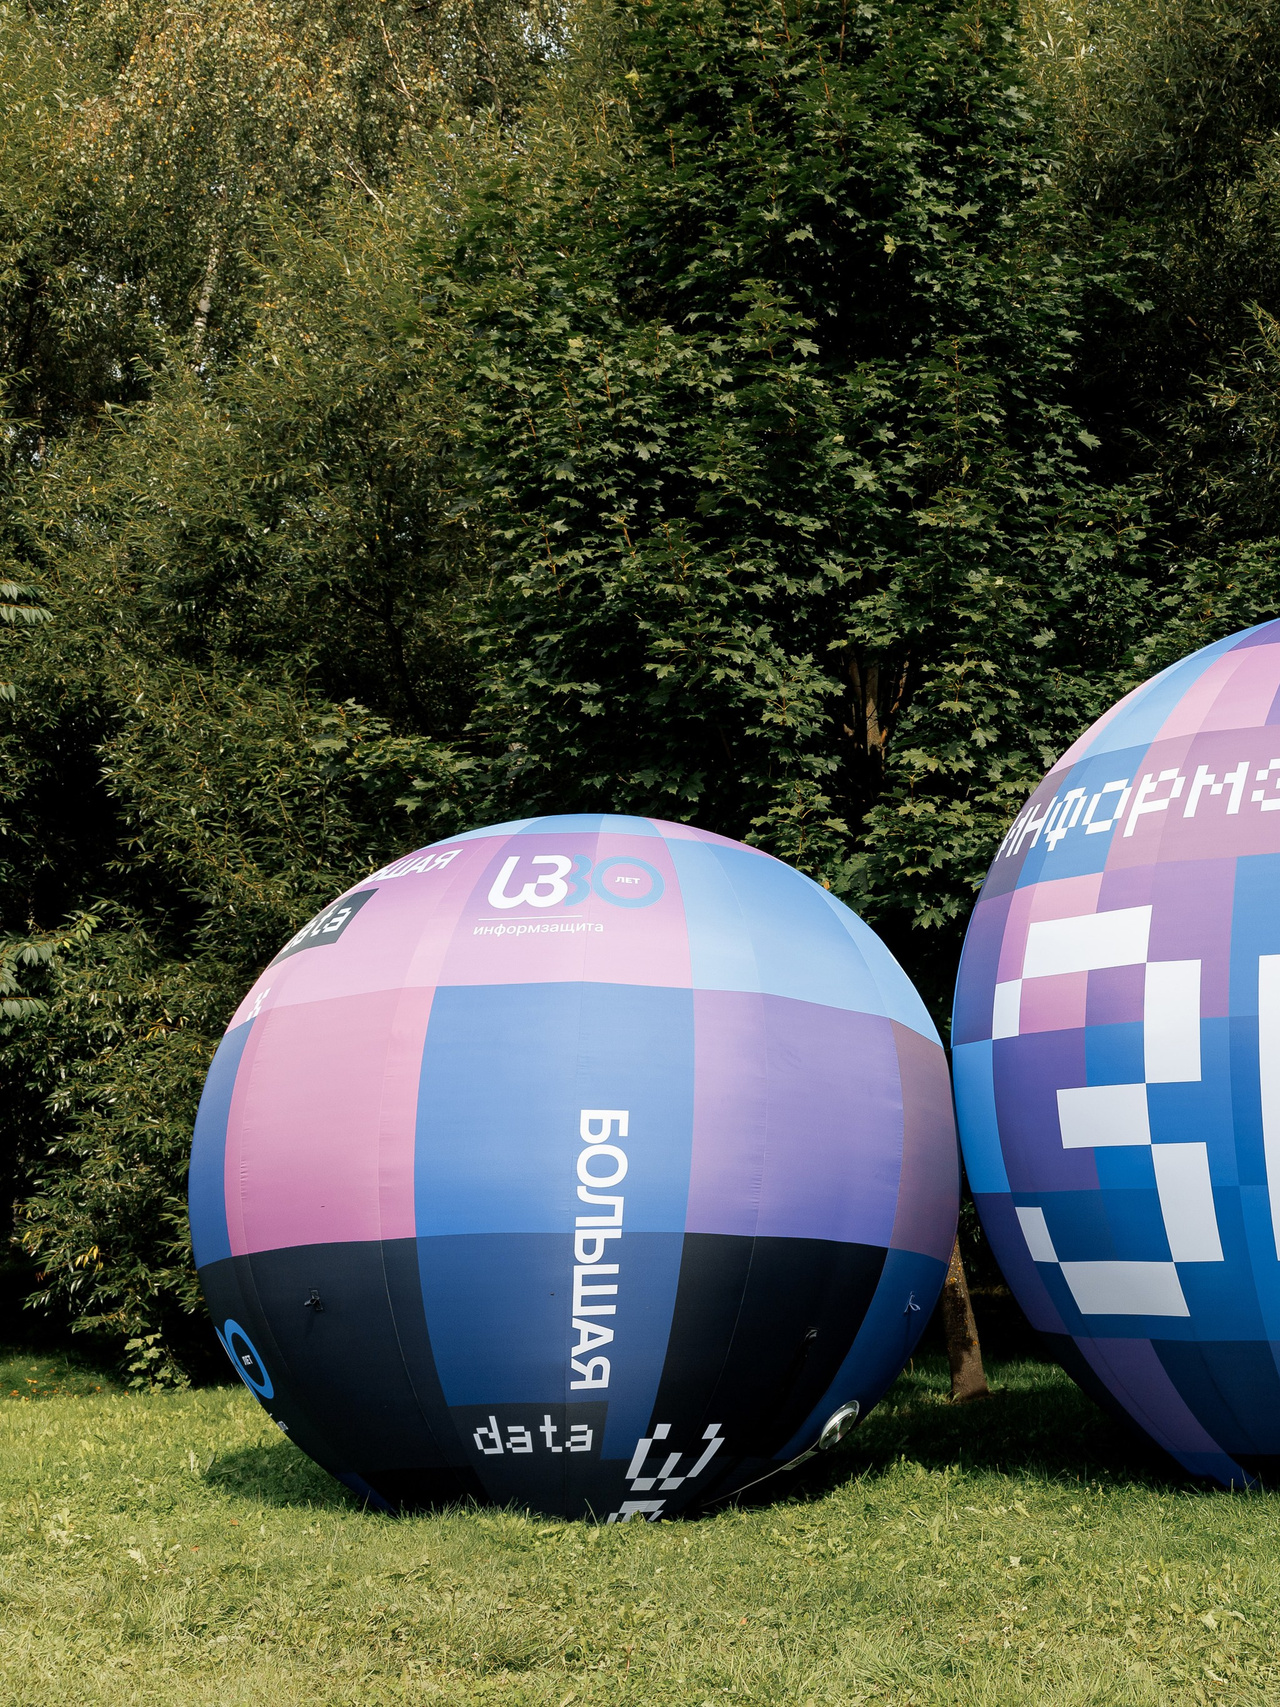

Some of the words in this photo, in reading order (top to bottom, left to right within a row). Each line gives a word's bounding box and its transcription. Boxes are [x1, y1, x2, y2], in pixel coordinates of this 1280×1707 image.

[615, 876, 641, 885] ЛЕТ
[473, 922, 604, 937] информзащита
[570, 1110, 629, 1390] БОЛЬШАЯ
[473, 1414, 593, 1455] data
